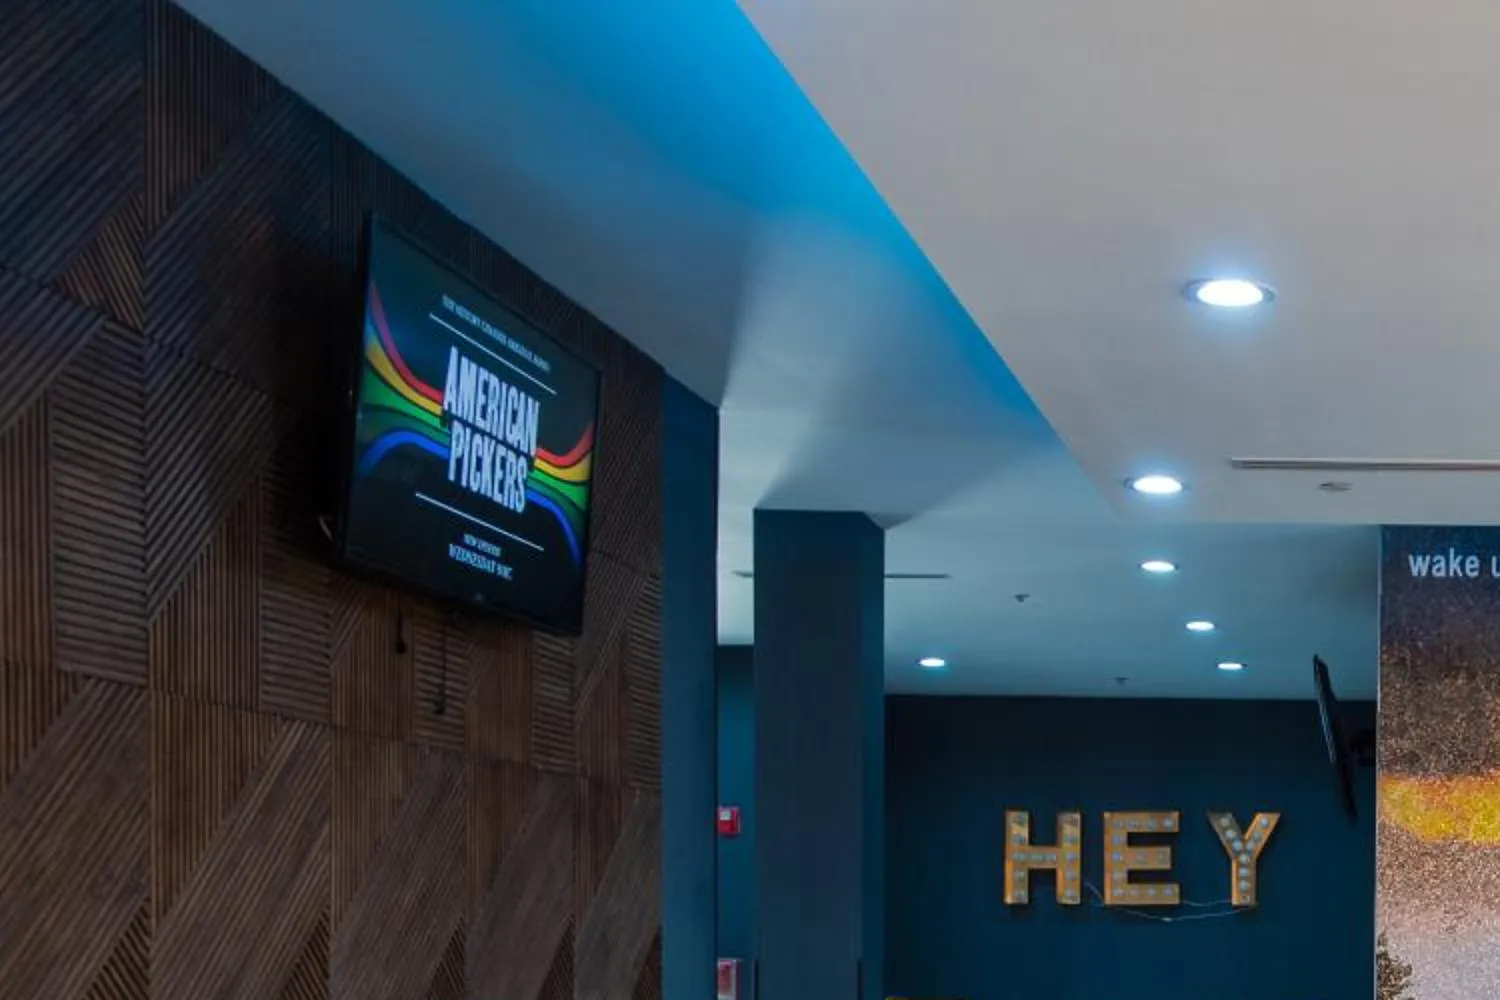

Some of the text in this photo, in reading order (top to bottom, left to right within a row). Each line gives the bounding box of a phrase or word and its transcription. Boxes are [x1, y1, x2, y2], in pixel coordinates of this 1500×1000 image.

[443, 345, 540, 457] AMERICAN
[448, 420, 528, 514] PICKERS
[1408, 547, 1480, 578] wake
[1004, 810, 1281, 905] HEY
